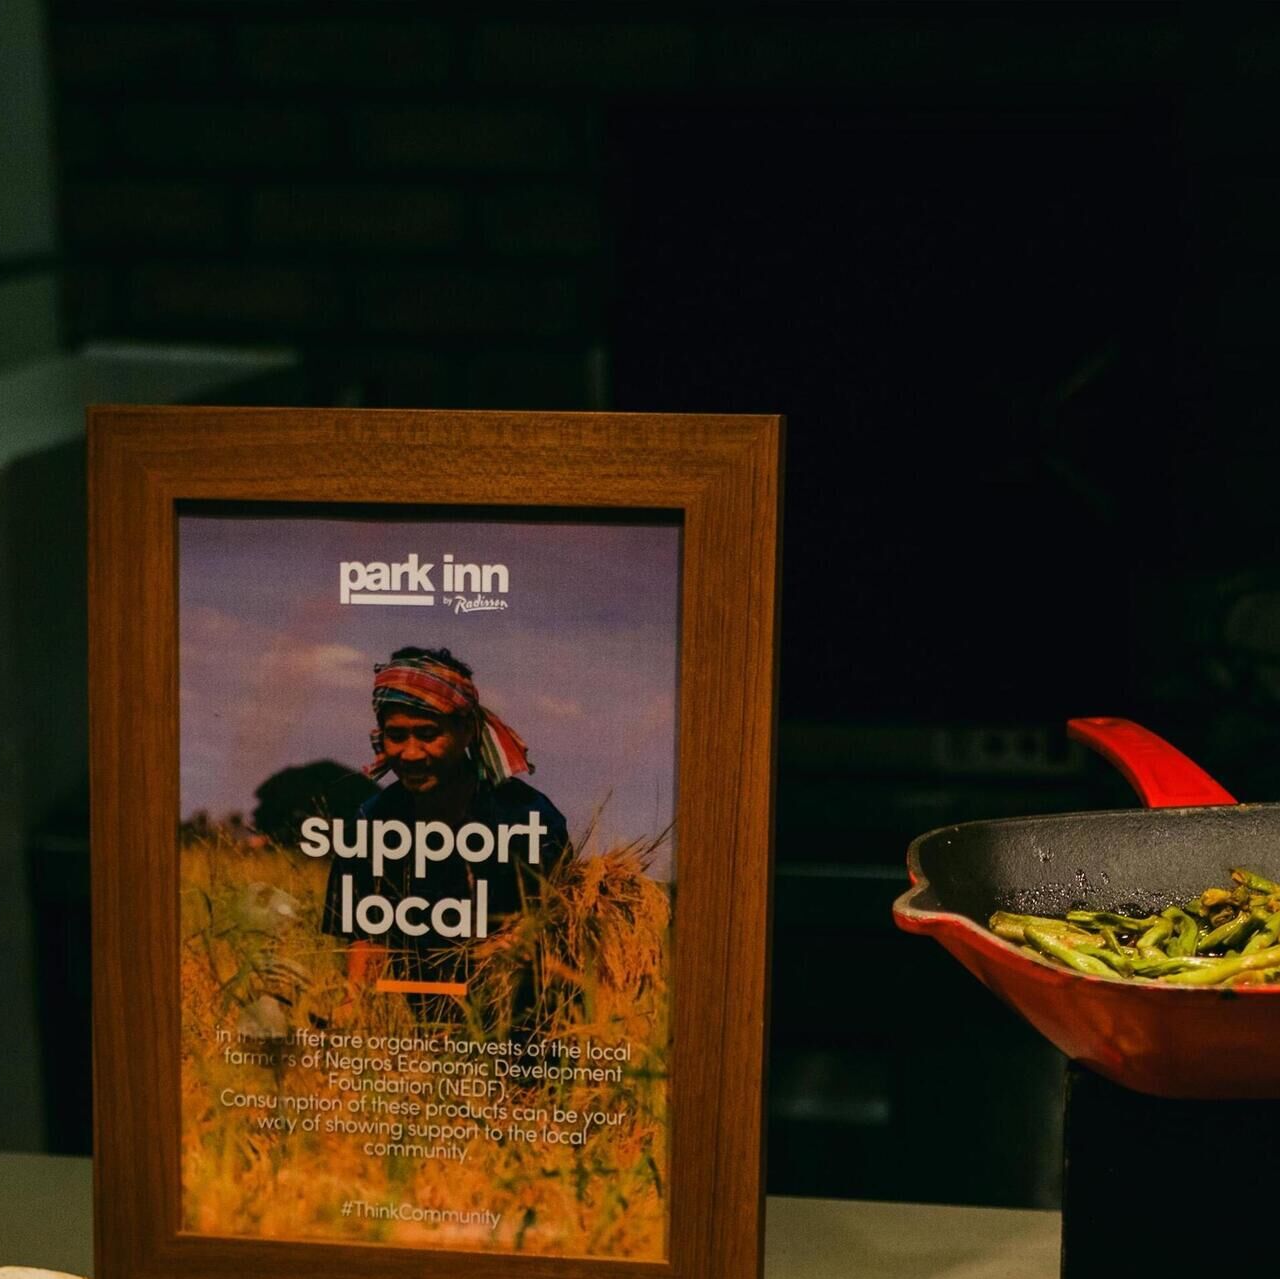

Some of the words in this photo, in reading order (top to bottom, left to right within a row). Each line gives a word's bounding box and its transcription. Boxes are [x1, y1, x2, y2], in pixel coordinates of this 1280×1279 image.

[340, 553, 436, 604] park
[443, 554, 509, 593] inn
[455, 594, 508, 614] Radisson
[300, 811, 547, 878] support
[341, 874, 488, 938] local
[216, 1025, 231, 1042] in
[330, 1034, 362, 1048] are
[367, 1033, 439, 1055] organic
[444, 1034, 522, 1056] harvests
[527, 1039, 546, 1056] of
[552, 1041, 581, 1059] the
[587, 1042, 631, 1061] local
[301, 1052, 320, 1068] of
[325, 1052, 392, 1074] Negros
[398, 1054, 488, 1076] Economic
[495, 1059, 623, 1084] Development
[328, 1072, 433, 1094] Foundation
[438, 1078, 509, 1102] (NEDF).
[348, 1097, 367, 1113] of
[372, 1098, 420, 1115] these
[426, 1101, 507, 1120] products
[512, 1107, 548, 1121] can
[553, 1106, 577, 1123] be
[582, 1112, 626, 1129] your
[302, 1115, 320, 1131] of
[325, 1117, 402, 1140] showing
[408, 1122, 479, 1140] support
[485, 1126, 503, 1141] to
[508, 1126, 537, 1141] the
[543, 1126, 587, 1144] local
[363, 1142, 472, 1164] community.
[340, 1201, 501, 1229] #ThinkCommunity
